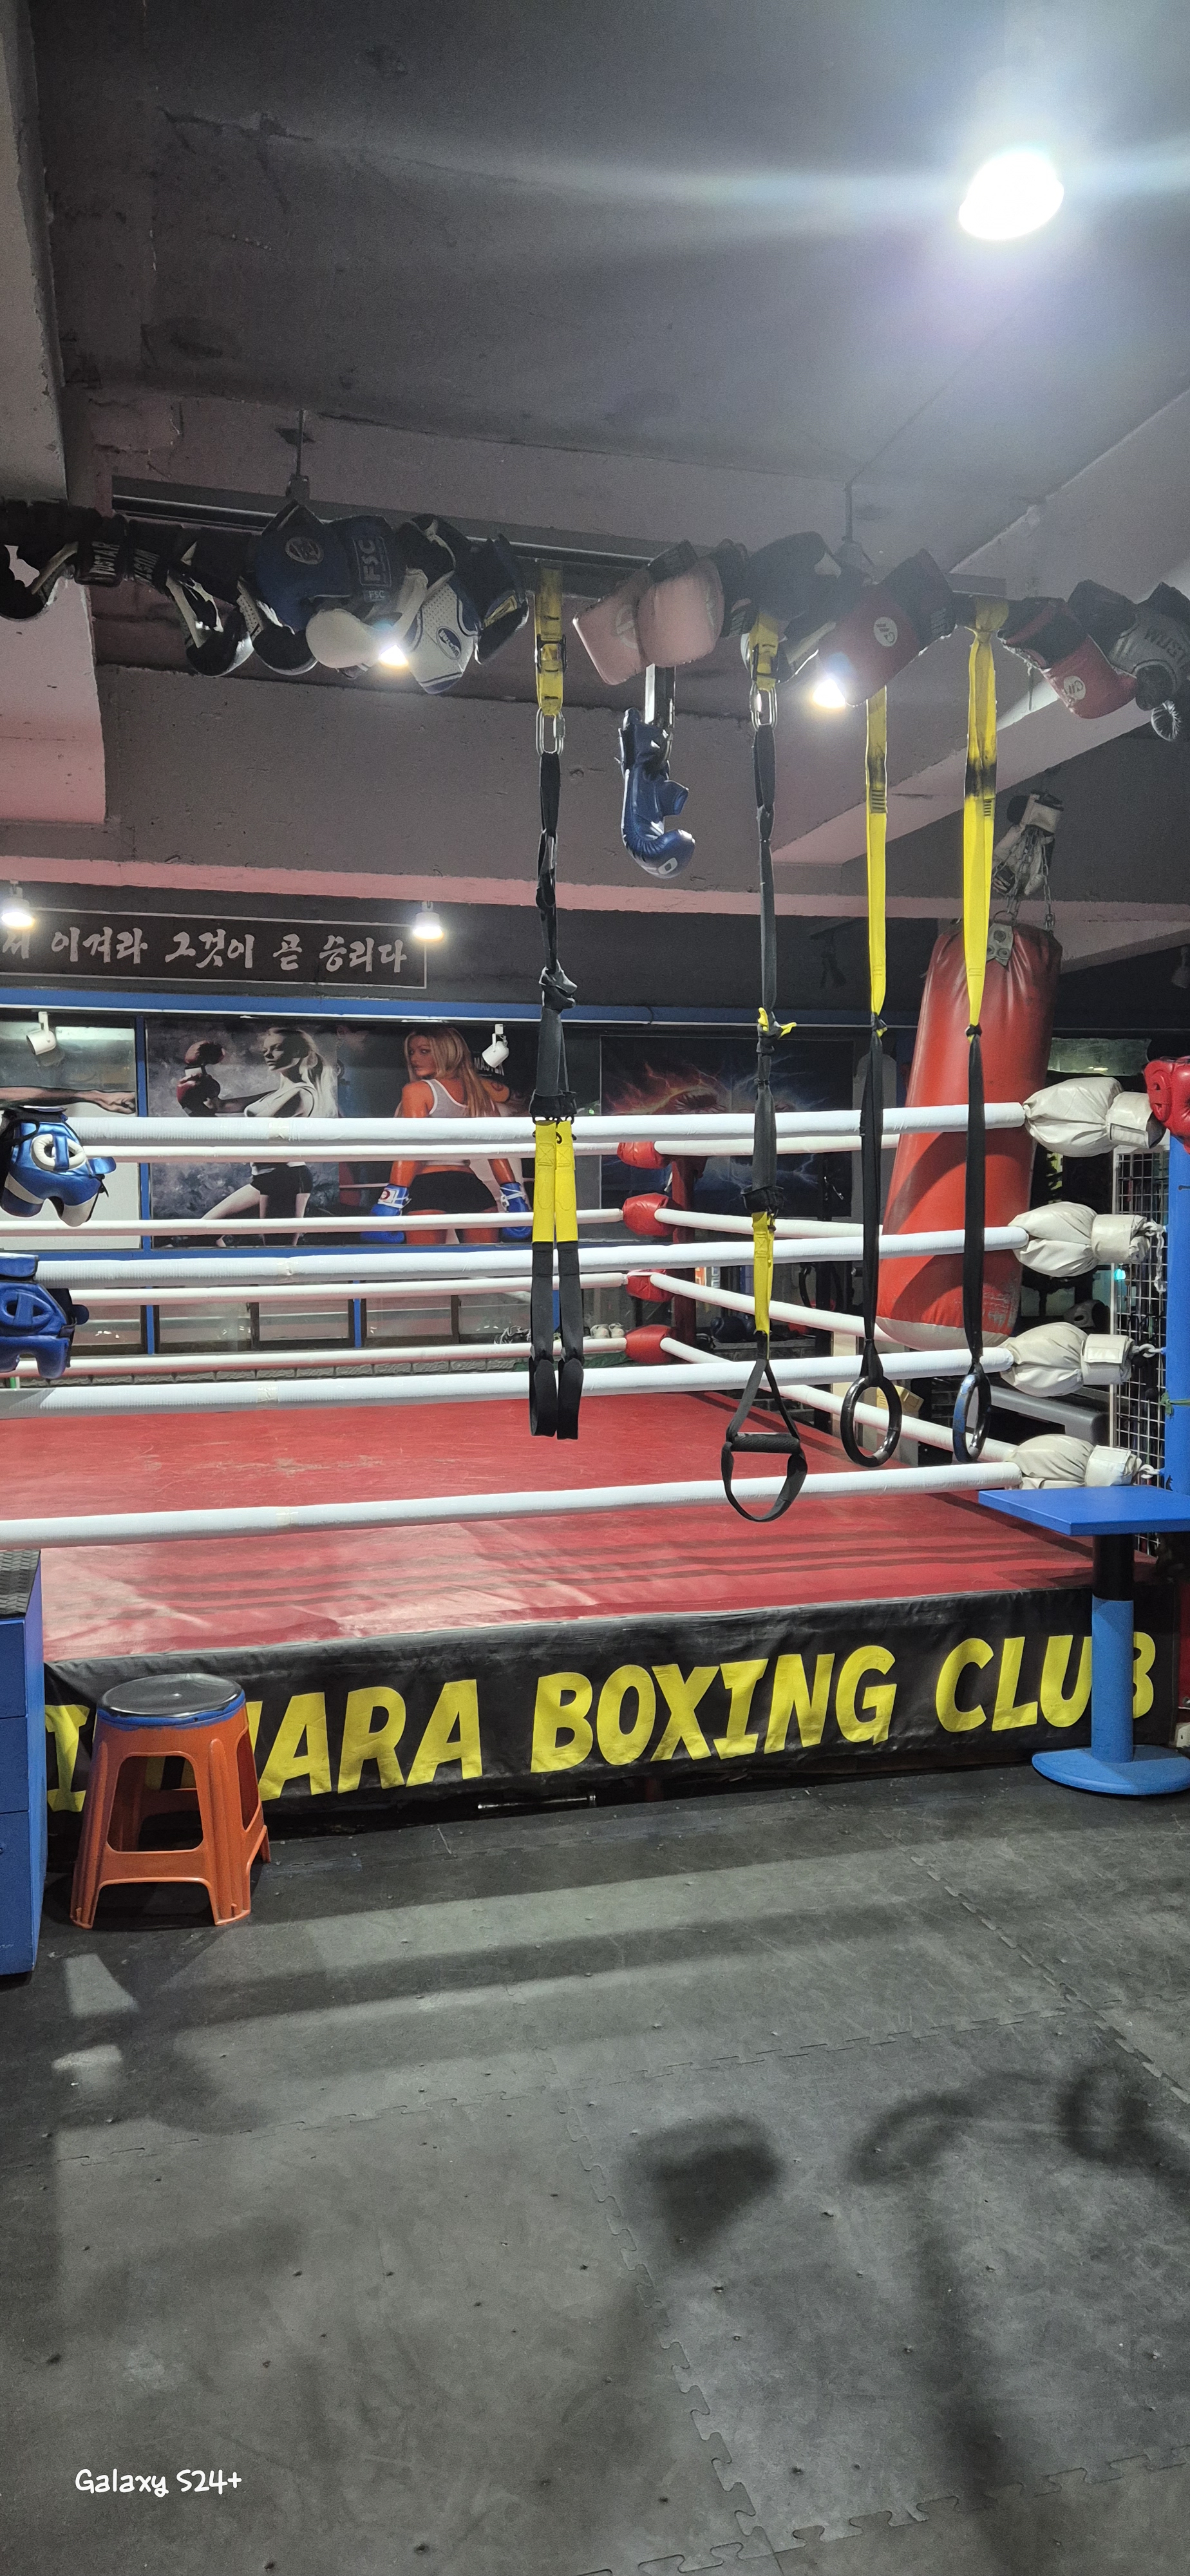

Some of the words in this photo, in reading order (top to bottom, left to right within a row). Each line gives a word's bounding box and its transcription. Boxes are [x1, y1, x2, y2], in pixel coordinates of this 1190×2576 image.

[358, 540, 381, 581] FSC
[368, 590, 386, 600] FSC
[51, 926, 148, 965] 이겨라
[165, 929, 255, 969] 그것이
[272, 933, 303, 971] 곧
[319, 936, 408, 973] 승리다
[531, 1644, 898, 1774] BOXING
